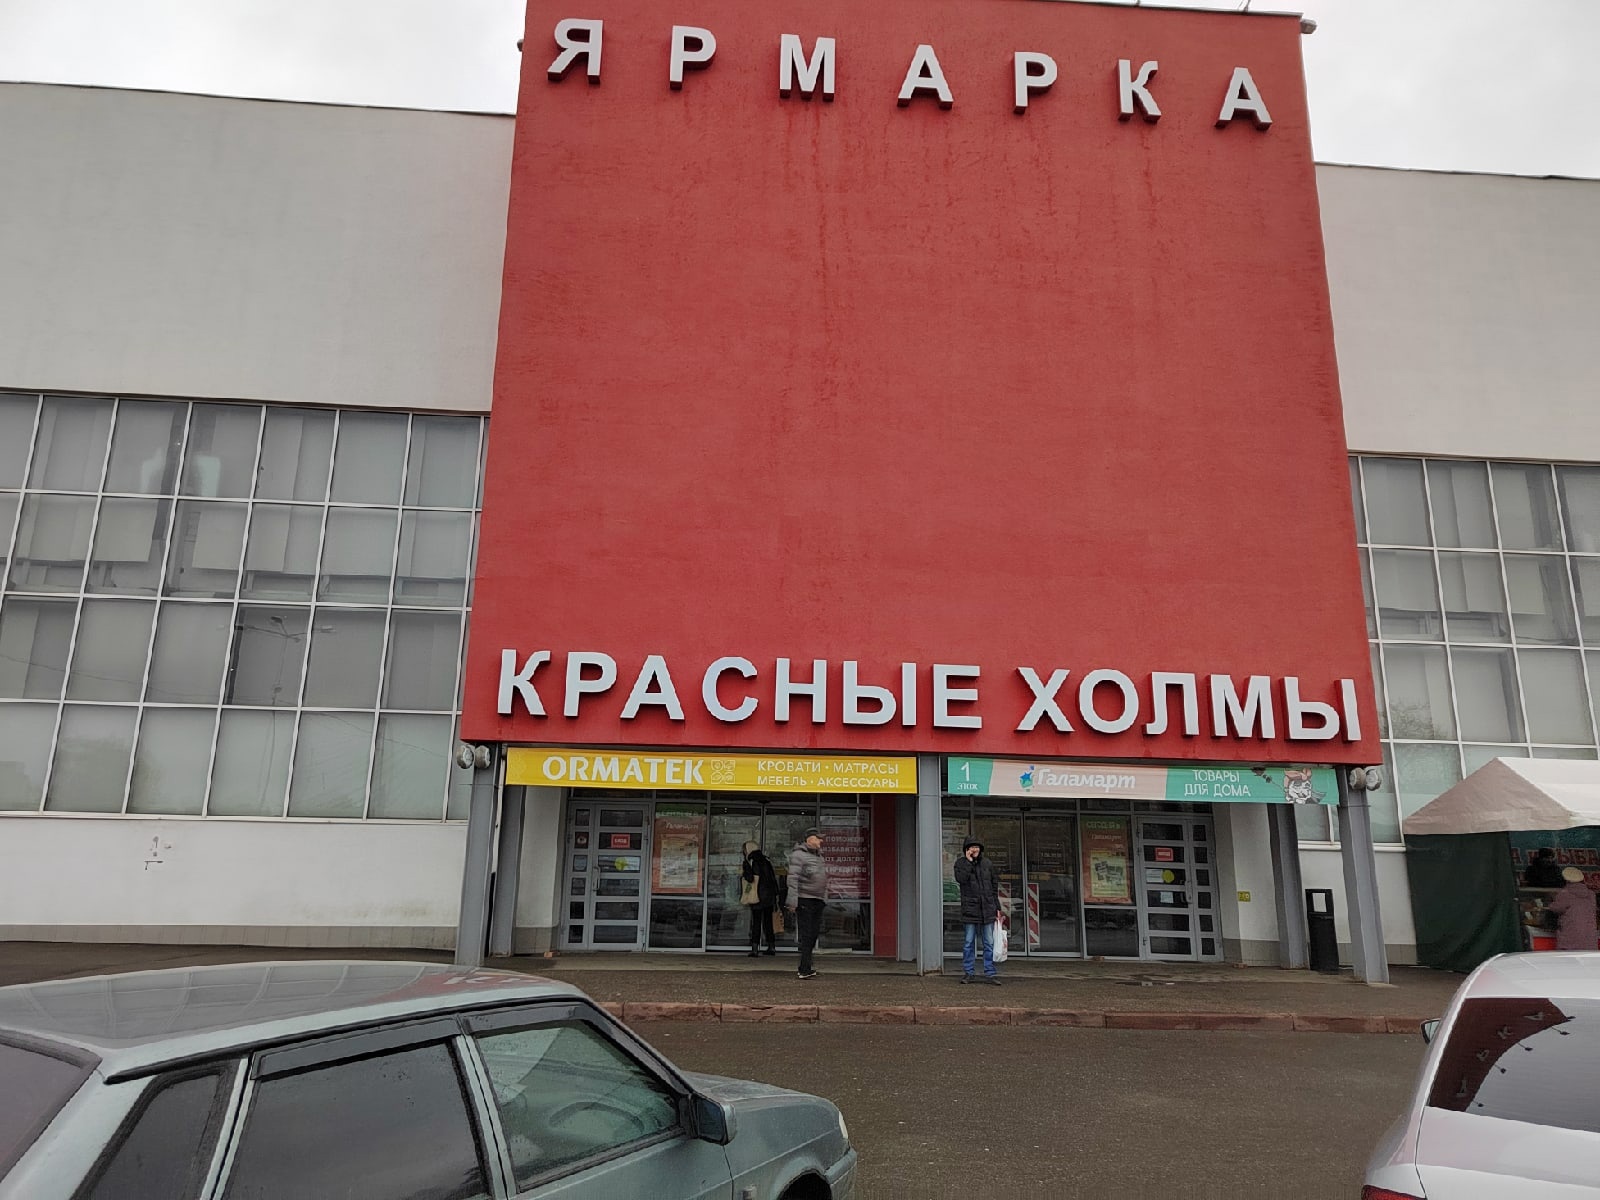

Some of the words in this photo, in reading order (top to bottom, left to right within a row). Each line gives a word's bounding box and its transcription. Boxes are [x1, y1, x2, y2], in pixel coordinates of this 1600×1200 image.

[547, 17, 1272, 129] ЯРМАРКА
[497, 648, 983, 729] КРАСНЫЕ
[1017, 667, 1362, 742] ХОЛМЫ
[542, 755, 704, 785] ORMATEK
[758, 760, 821, 773] КРОВАТИ
[833, 762, 899, 775] МАТРАСЫ
[960, 761, 971, 782] 1
[1192, 769, 1240, 783] ТОВАРЫ
[757, 775, 807, 786] МЕБЕЛЬ
[817, 777, 899, 789] АКСЕССУАРЫ
[1037, 768, 1137, 793] Галамарт
[1184, 783, 1209, 796] ДЛЯ
[1213, 784, 1251, 798] ДОМА
